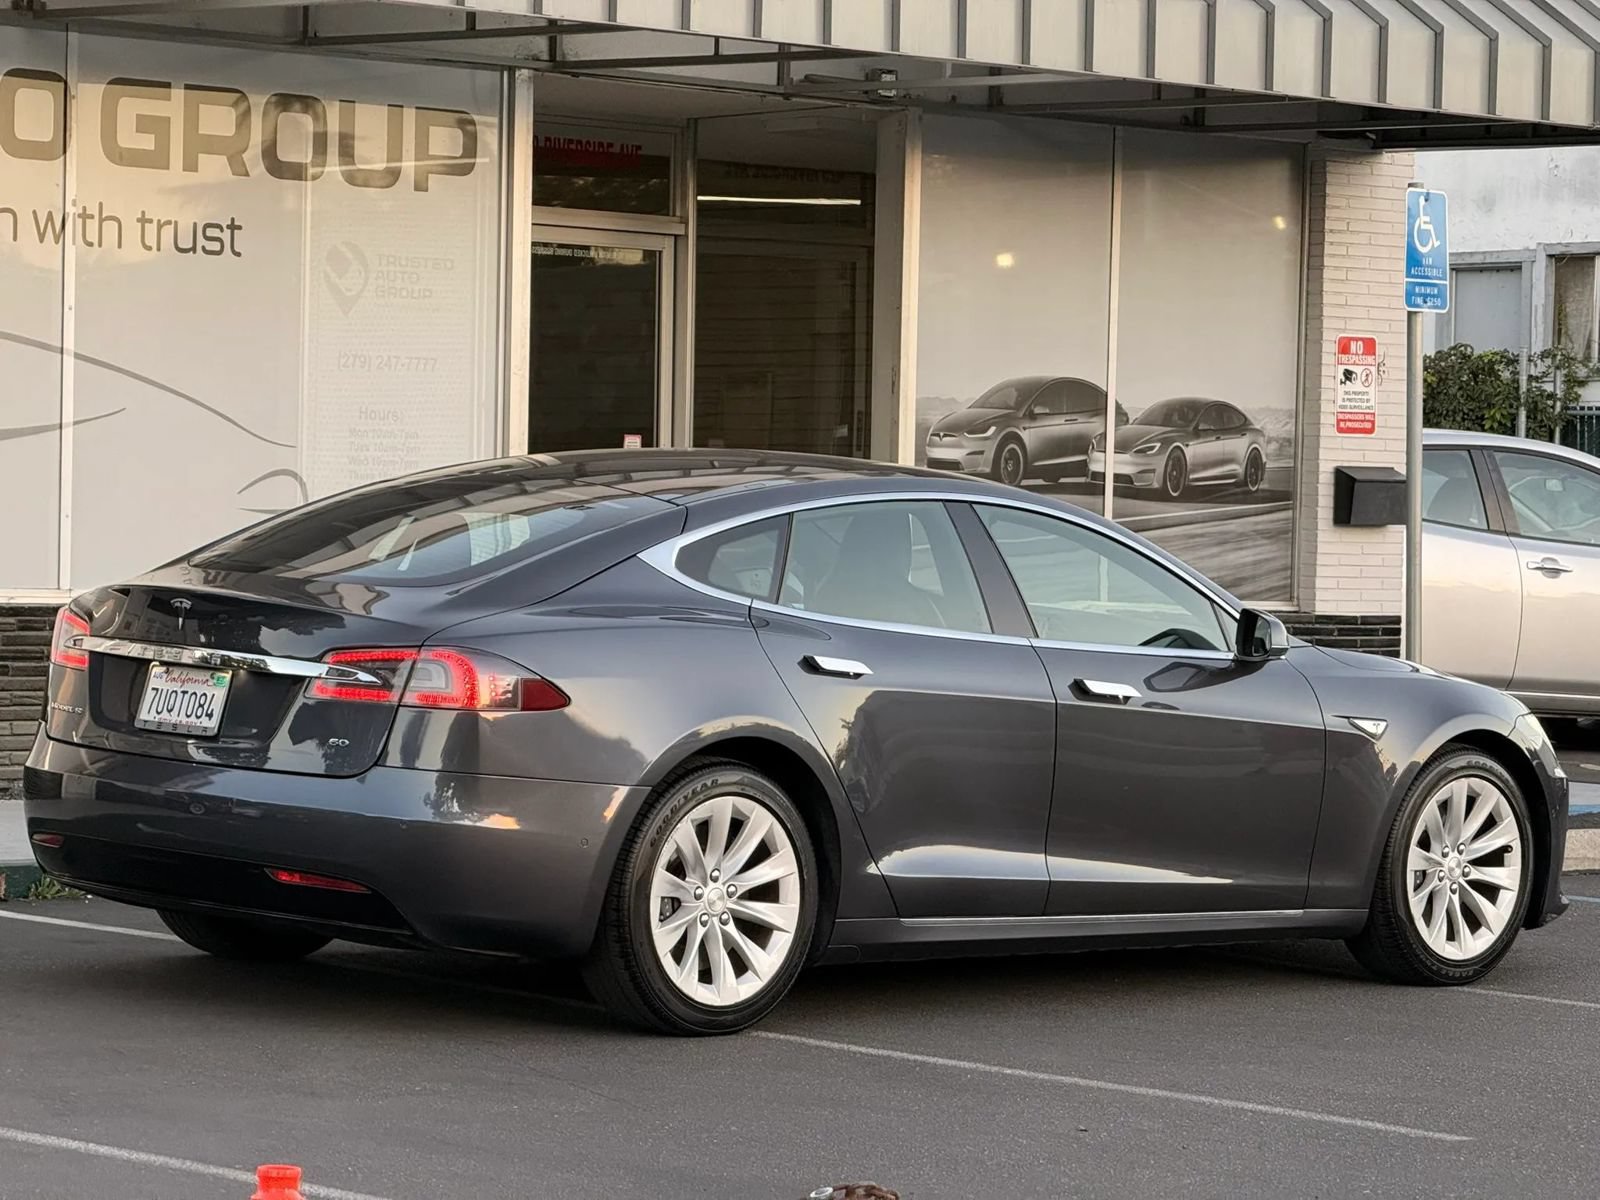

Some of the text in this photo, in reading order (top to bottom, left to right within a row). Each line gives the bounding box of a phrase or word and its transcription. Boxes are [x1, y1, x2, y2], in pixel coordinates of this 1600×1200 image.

[100, 76, 479, 192] GROUP
[32, 201, 123, 249] with
[135, 210, 243, 257] trust
[376, 253, 455, 272] TRUSTED
[375, 270, 421, 285] AUTO
[1411, 266, 1443, 277] ACCESSIBLE
[375, 284, 433, 300] GROUP
[1415, 285, 1439, 295] MINIMUM
[1411, 296, 1424, 304] FINE
[1350, 340, 1364, 354] NO
[337, 350, 438, 373] (279) 247-7777
[1338, 354, 1376, 365] TRESPASSING
[164, 669, 213, 688] California
[147, 687, 215, 721] 7UQT084
[142, 720, 209, 735] TESLA
[650, 778, 720, 848] GOODYEAR
